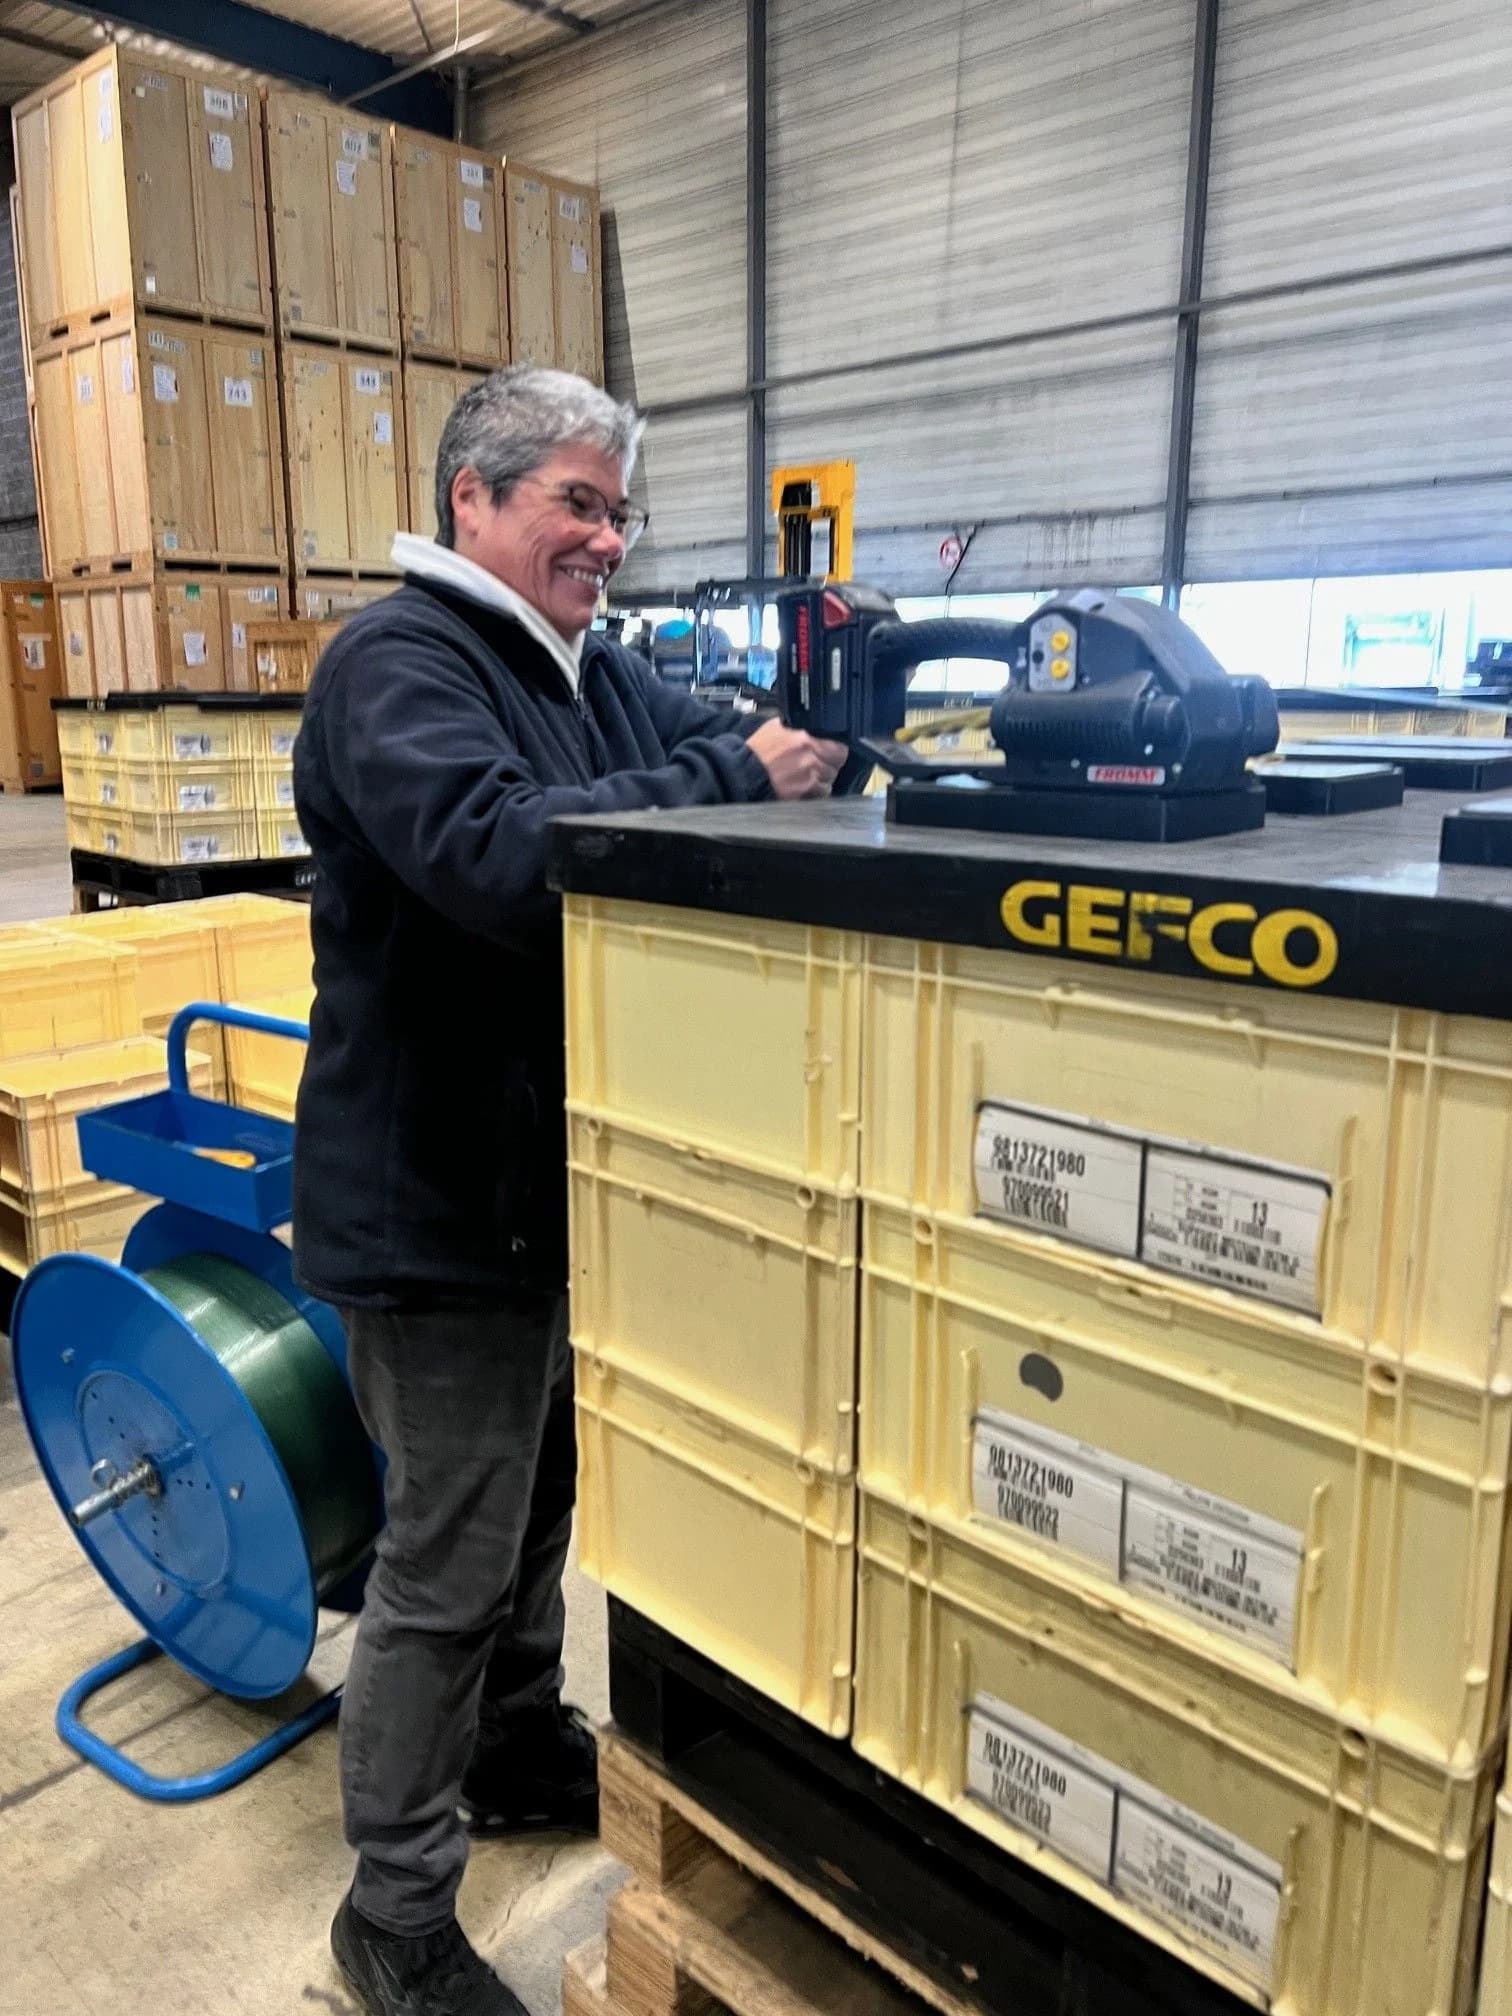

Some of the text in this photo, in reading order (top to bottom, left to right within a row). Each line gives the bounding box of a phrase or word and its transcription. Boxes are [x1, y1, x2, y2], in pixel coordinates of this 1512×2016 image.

[1093, 766, 1159, 783] FROMM
[1000, 880, 1339, 987] GEFCO
[992, 1134, 1086, 1177] 9813721980
[1252, 1200, 1268, 1227] 13
